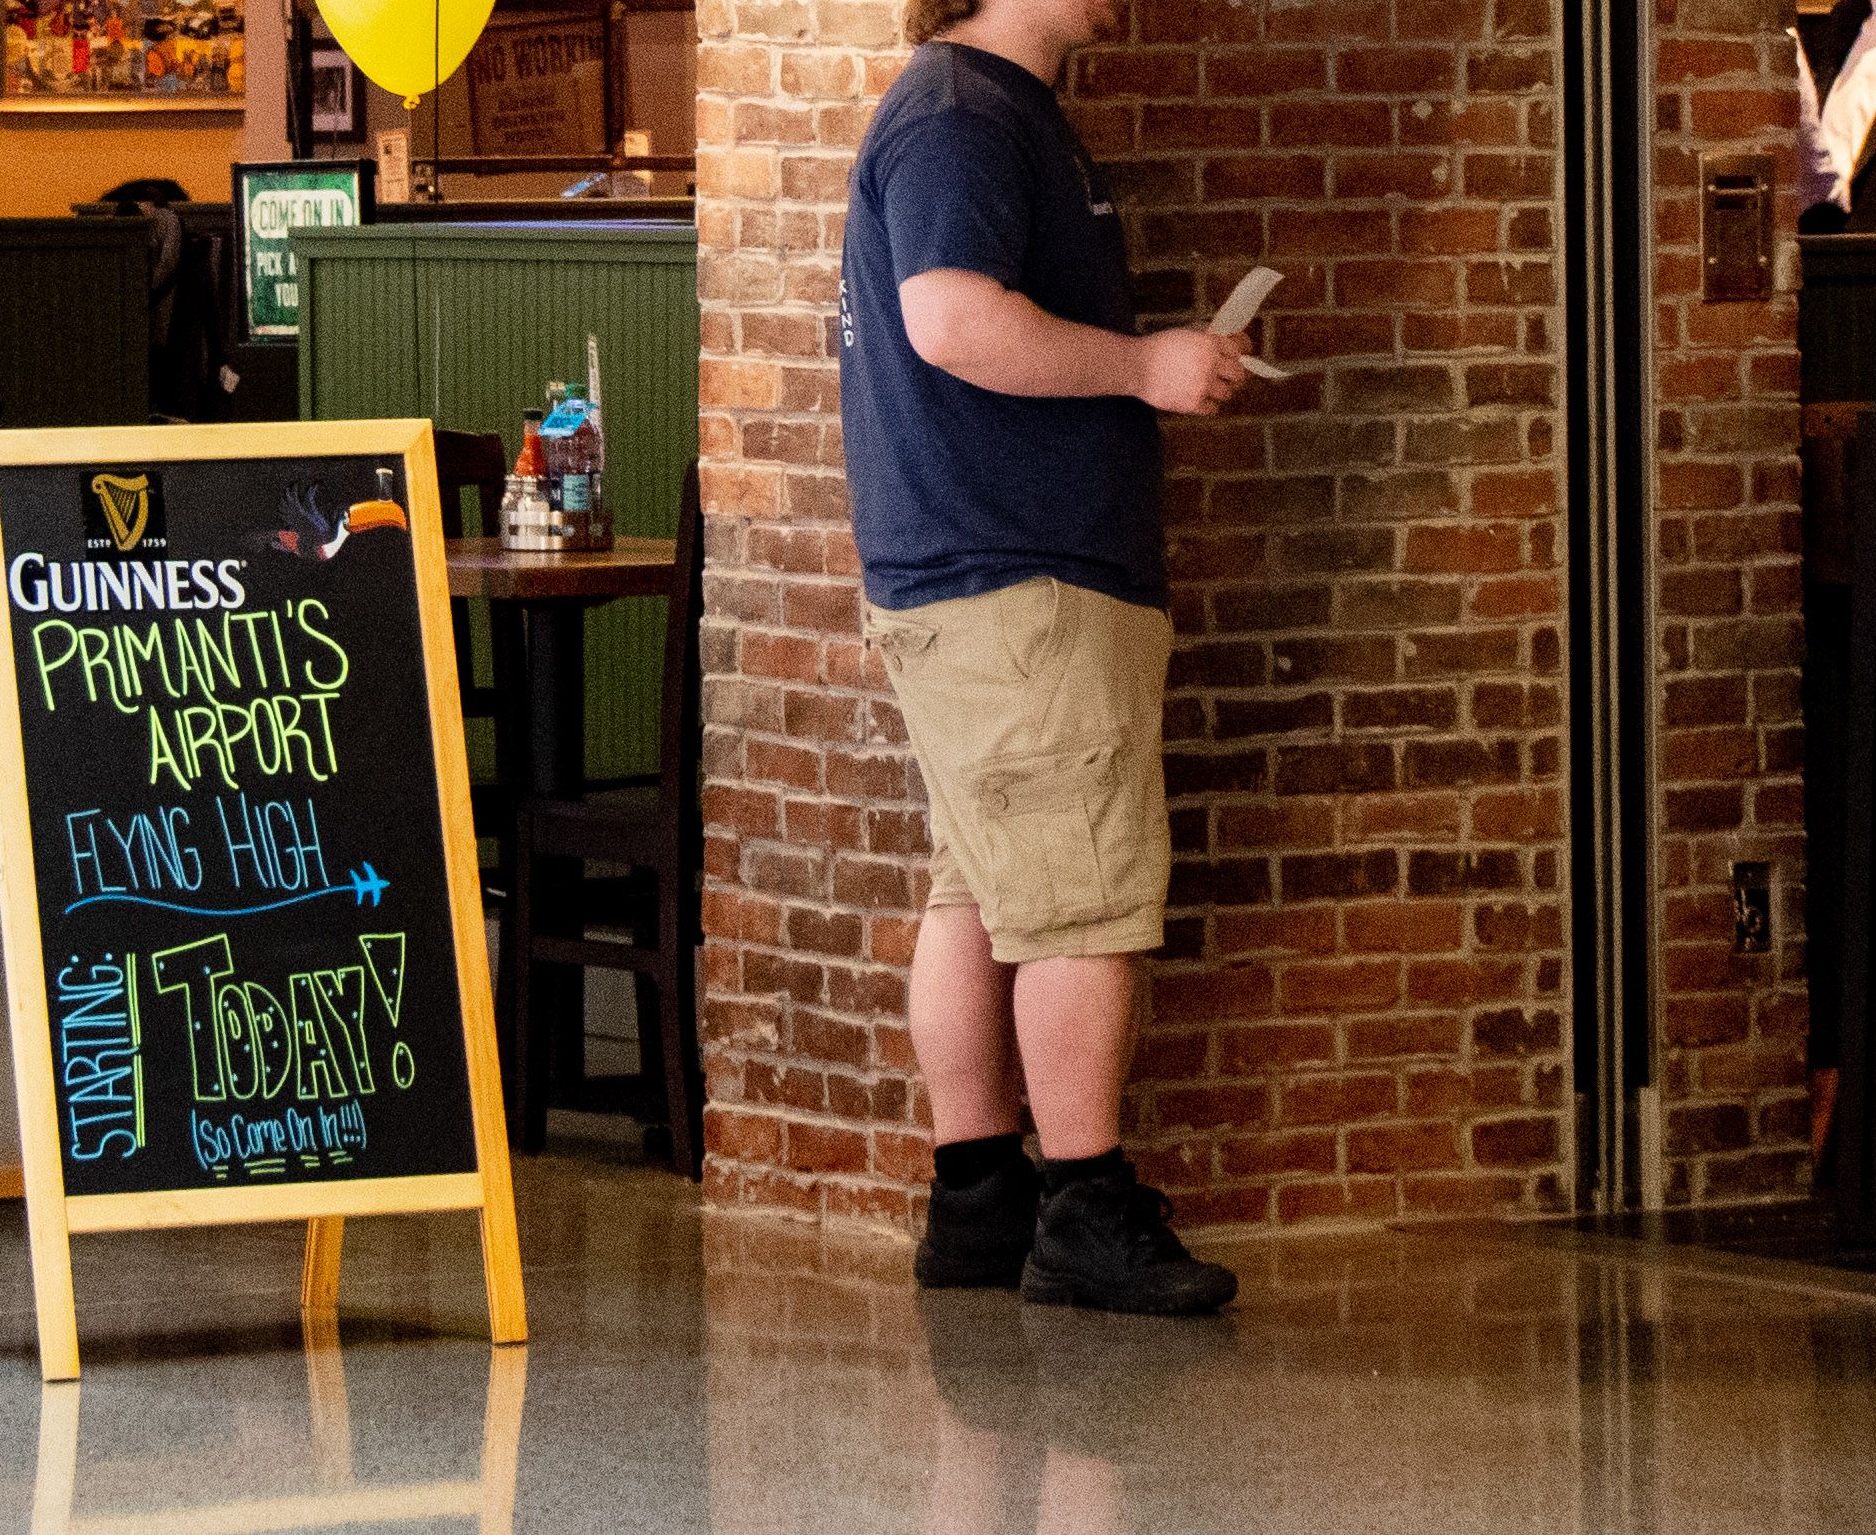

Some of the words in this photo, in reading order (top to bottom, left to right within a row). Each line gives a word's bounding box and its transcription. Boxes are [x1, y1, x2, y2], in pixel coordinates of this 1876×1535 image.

[259, 199, 297, 231] COME
[303, 199, 322, 226] ON
[330, 199, 345, 226] IN
[9, 552, 246, 611] GUINNESS
[143, 537, 167, 548] 1759
[32, 598, 349, 713] PRIMANTI'S
[150, 692, 341, 791] AIRPORT
[65, 805, 202, 895] FLYING
[216, 792, 330, 890] HIGH
[57, 952, 139, 1160] STARTING:
[151, 932, 416, 1101] TODAY!
[287, 1106, 317, 1151] On
